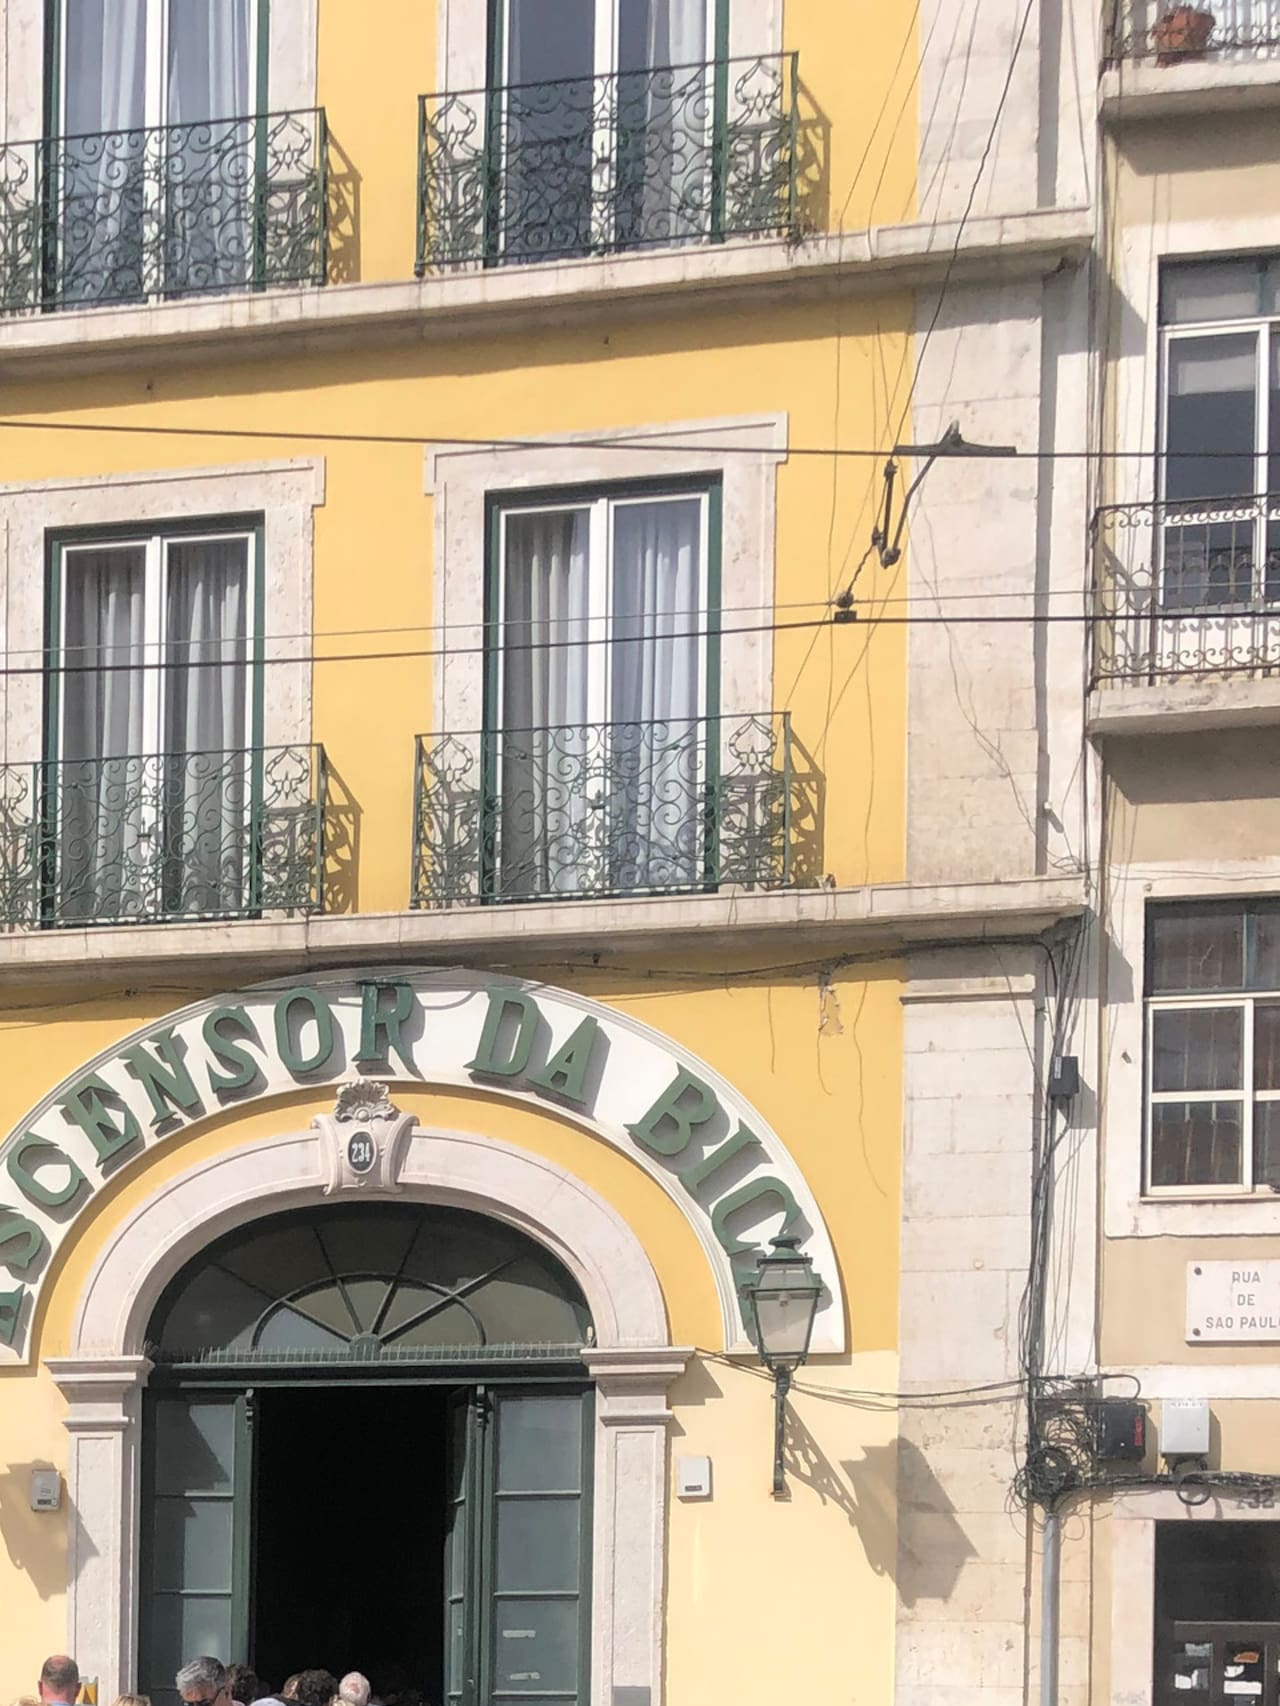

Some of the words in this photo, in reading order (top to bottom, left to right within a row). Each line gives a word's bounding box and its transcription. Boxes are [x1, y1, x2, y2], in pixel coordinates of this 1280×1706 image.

[463, 984, 588, 1105] DA
[351, 1142, 371, 1162] 234
[1231, 1271, 1261, 1284] RUA
[1236, 1293, 1256, 1306] DE
[1239, 1316, 1280, 1329] PAUL
